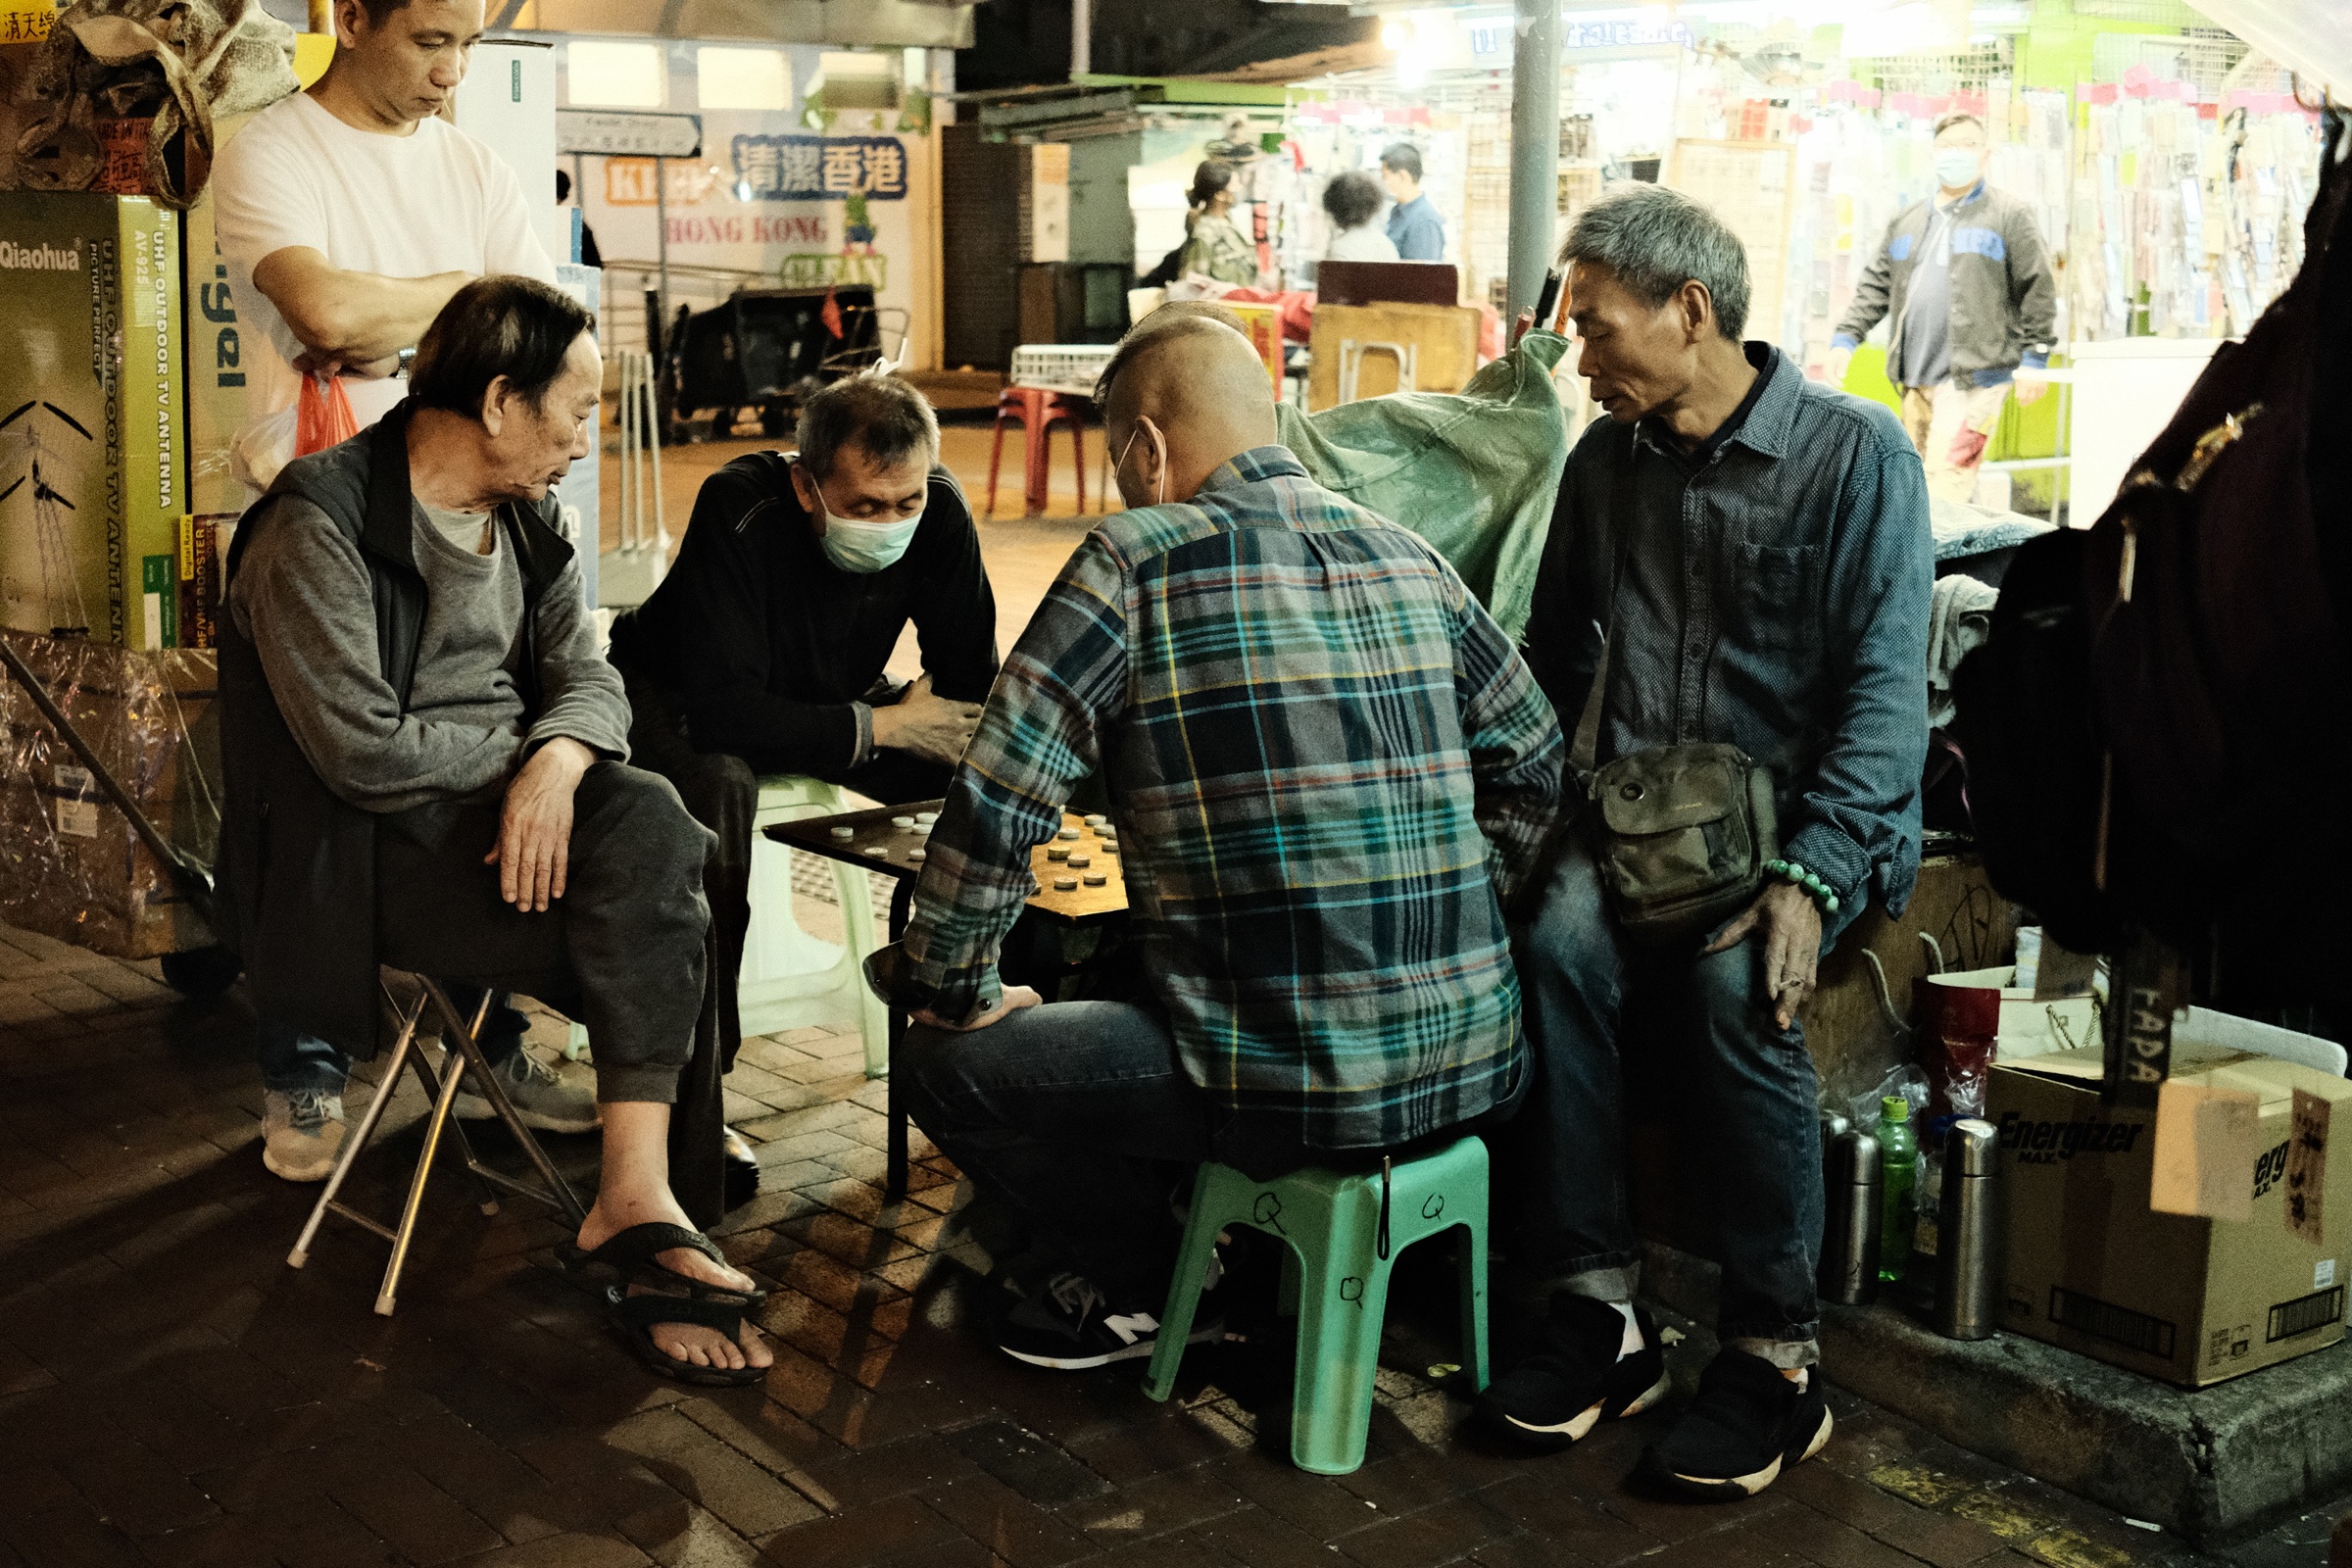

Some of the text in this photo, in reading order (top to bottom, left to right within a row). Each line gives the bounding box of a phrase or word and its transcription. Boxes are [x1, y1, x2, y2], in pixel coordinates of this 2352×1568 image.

[153, 231, 166, 272] UHF
[666, 217, 827, 245] HONG KONG
[0, 240, 80, 271] Qiaohua
[134, 230, 149, 284] AV-925
[90, 243, 102, 370] PICTURE PERFECT
[155, 278, 169, 374] OUTDOOR
[157, 379, 170, 406] TV
[158, 410, 172, 509] ANTENNA
[106, 518, 122, 648] ANTENN
[195, 528, 206, 597] BOOSTER
[1998, 1111, 2144, 1160] Energizer
[1253, 1192, 1286, 1235] Q
[1422, 1193, 1446, 1221] Q
[1340, 1276, 1363, 1309] Q
